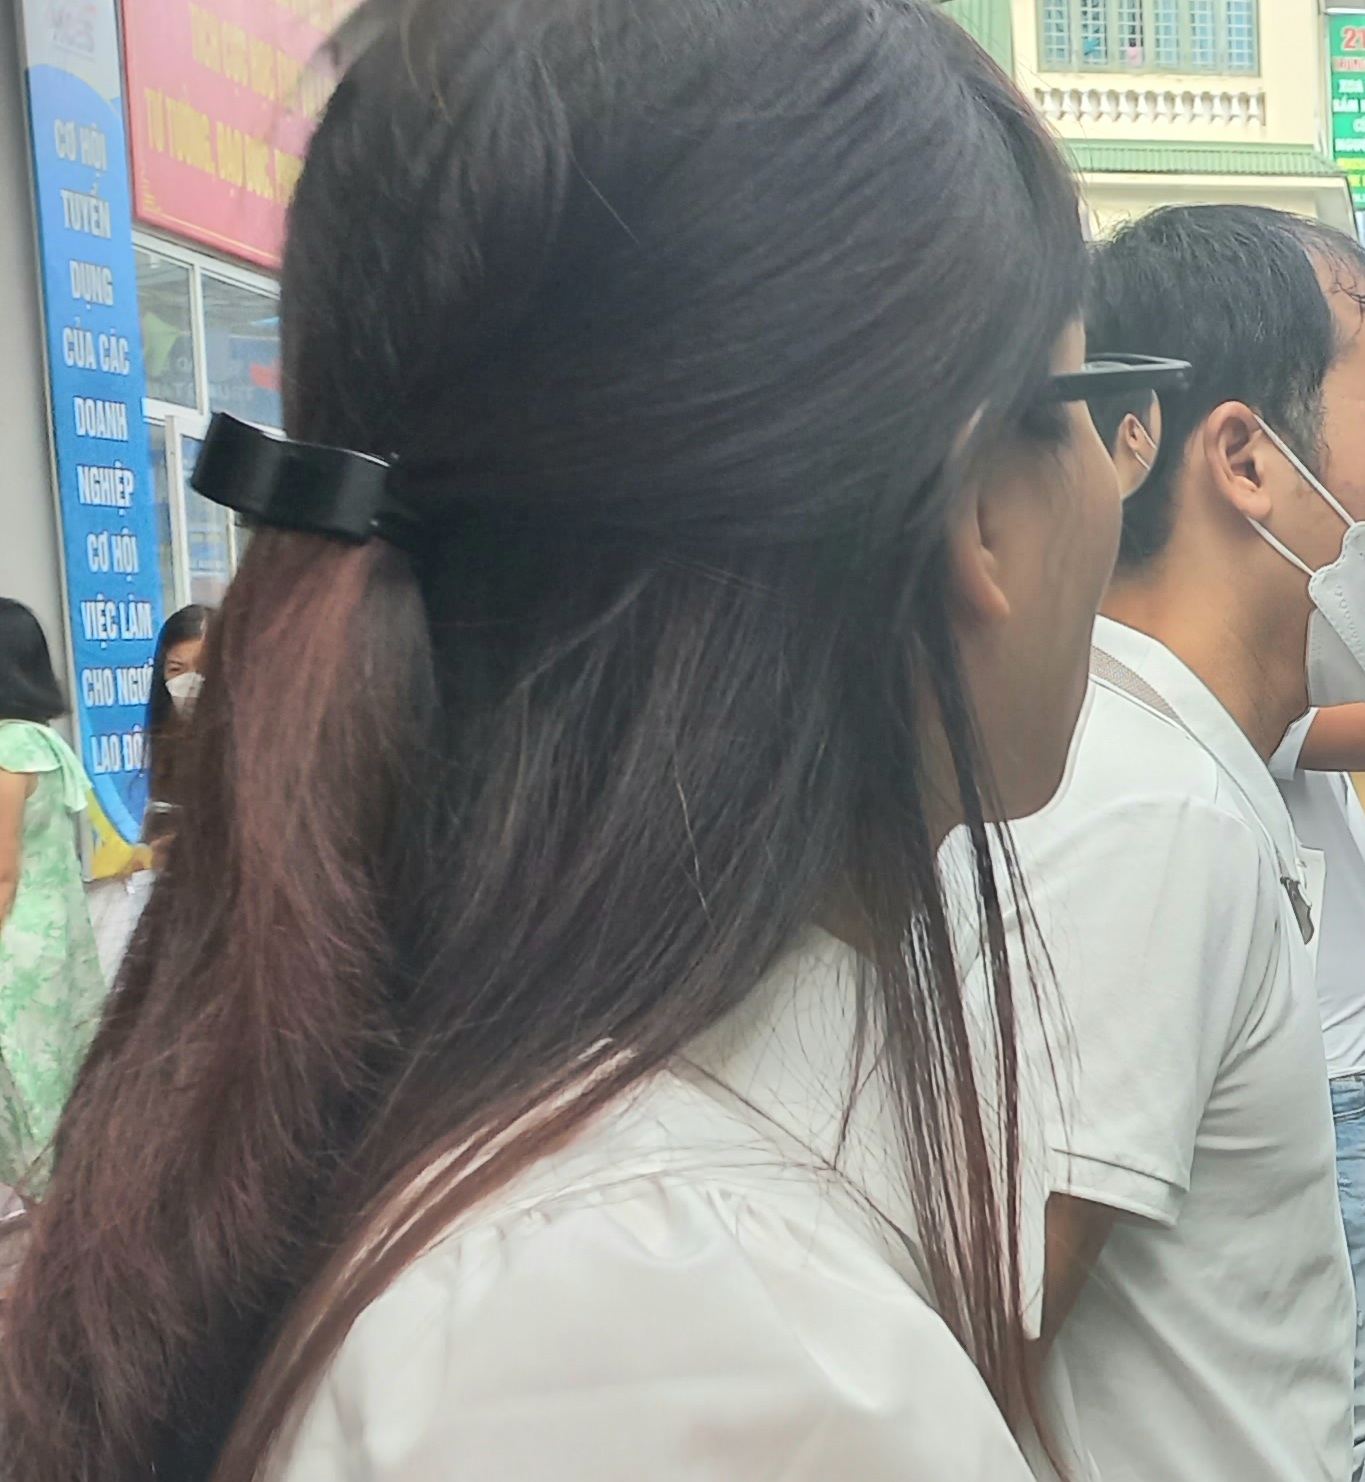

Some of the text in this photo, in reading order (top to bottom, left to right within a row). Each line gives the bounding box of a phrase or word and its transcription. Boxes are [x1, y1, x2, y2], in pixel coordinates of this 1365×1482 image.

[54, 119, 107, 177] CƠ HỘI
[60, 184, 111, 239] TUYỂN
[69, 260, 114, 310] DỤNG
[63, 316, 130, 376] CỦA CÁC
[73, 396, 128, 442] DOANH
[77, 460, 134, 516] NGHIỆP
[86, 528, 140, 582] CƠ HỘI
[81, 593, 153, 649] VIỆC LÀM
[82, 667, 113, 707] CHO
[91, 734, 121, 775] LAO
